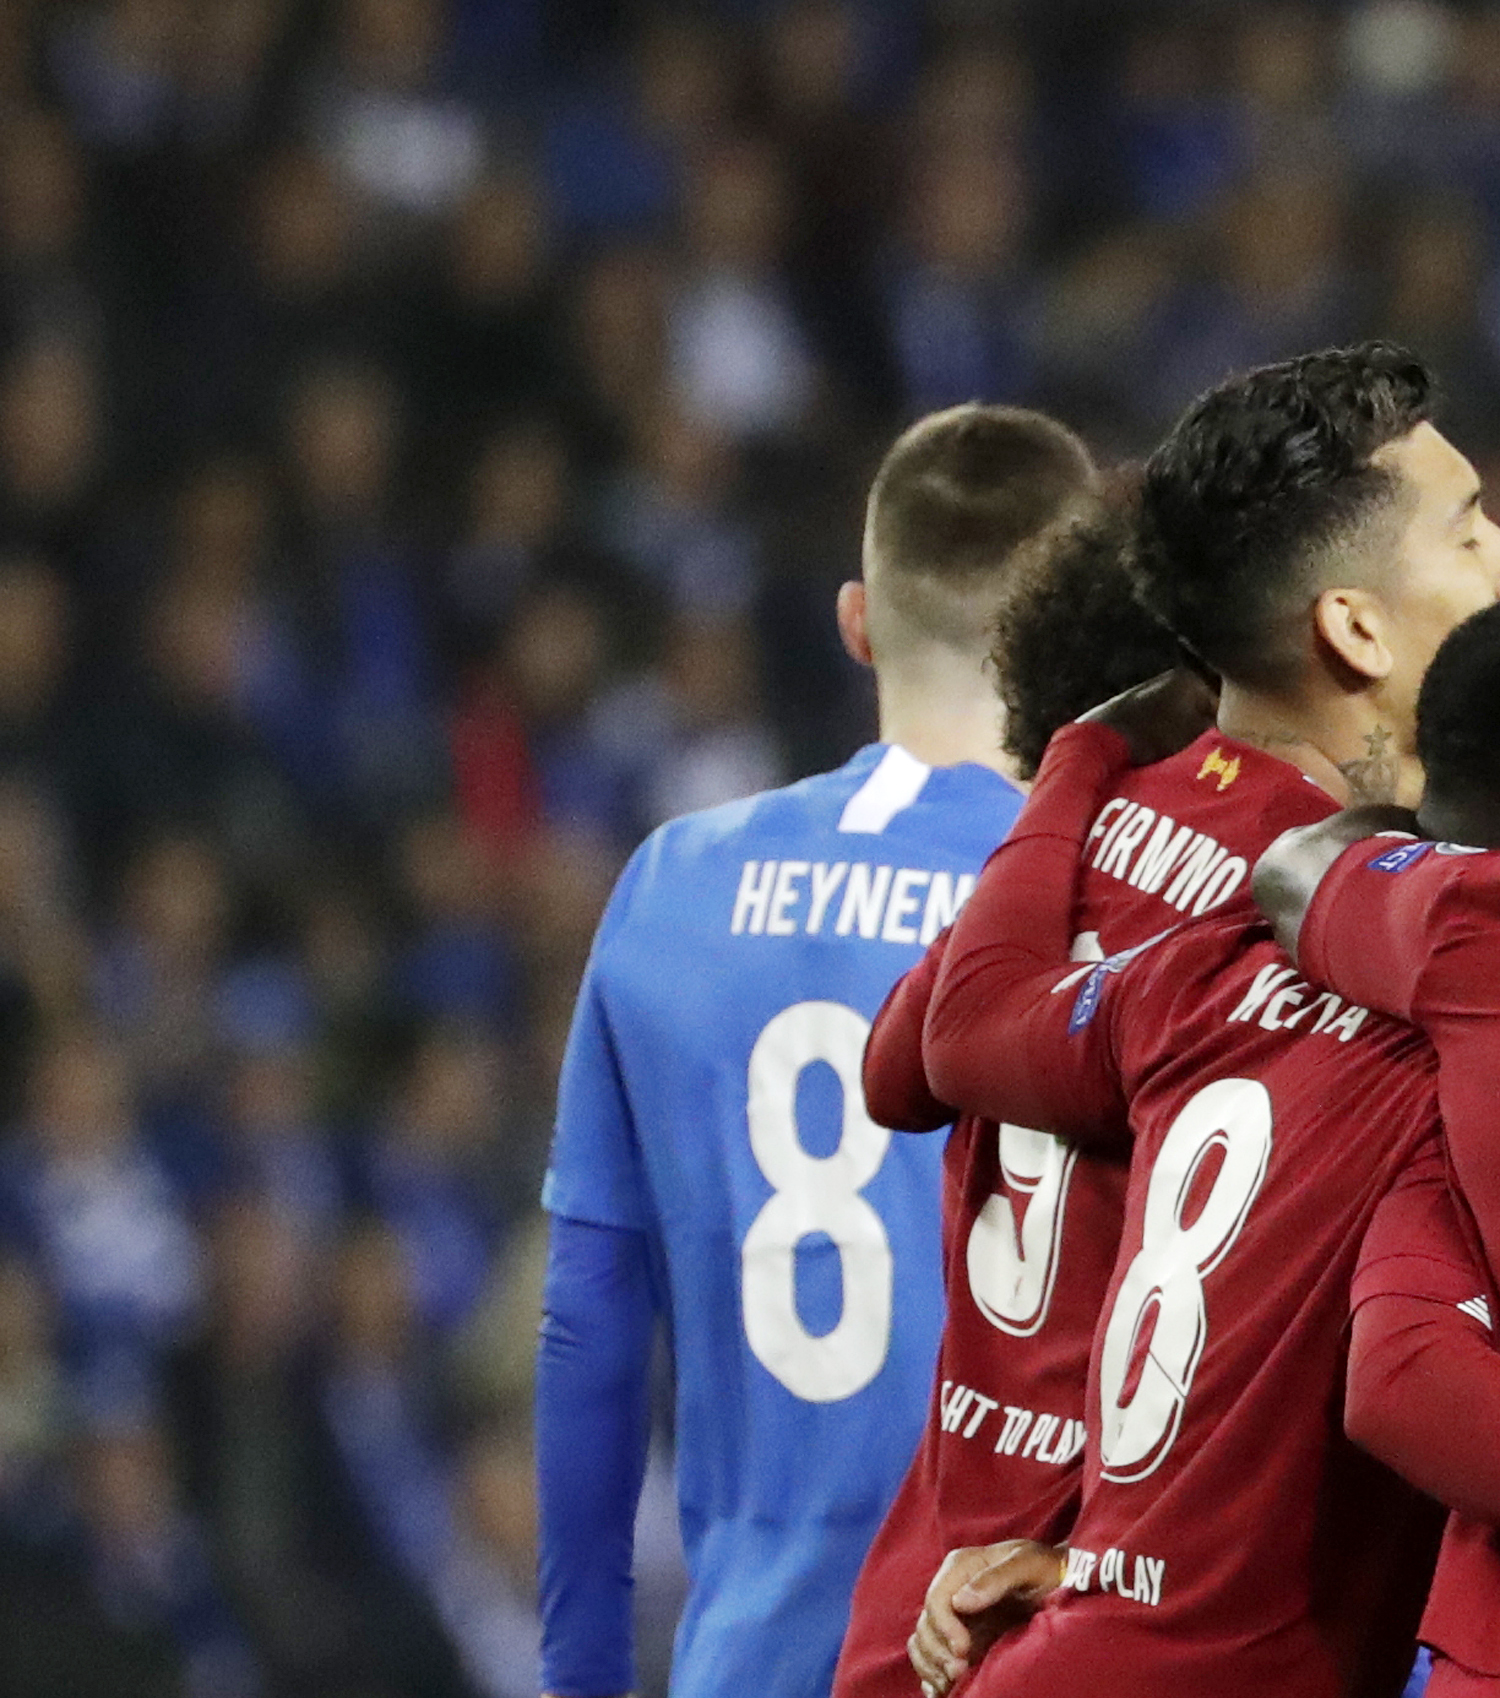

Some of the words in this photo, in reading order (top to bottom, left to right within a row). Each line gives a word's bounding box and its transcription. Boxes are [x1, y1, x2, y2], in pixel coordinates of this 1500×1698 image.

[730, 860, 977, 946] HEYNEN
[742, 1001, 892, 1402] 8
[1099, 1077, 1273, 1483] 8
[994, 1406, 1033, 1456] TO
[1021, 1413, 1089, 1465] PLAY
[1099, 1547, 1165, 1606] PLAY
